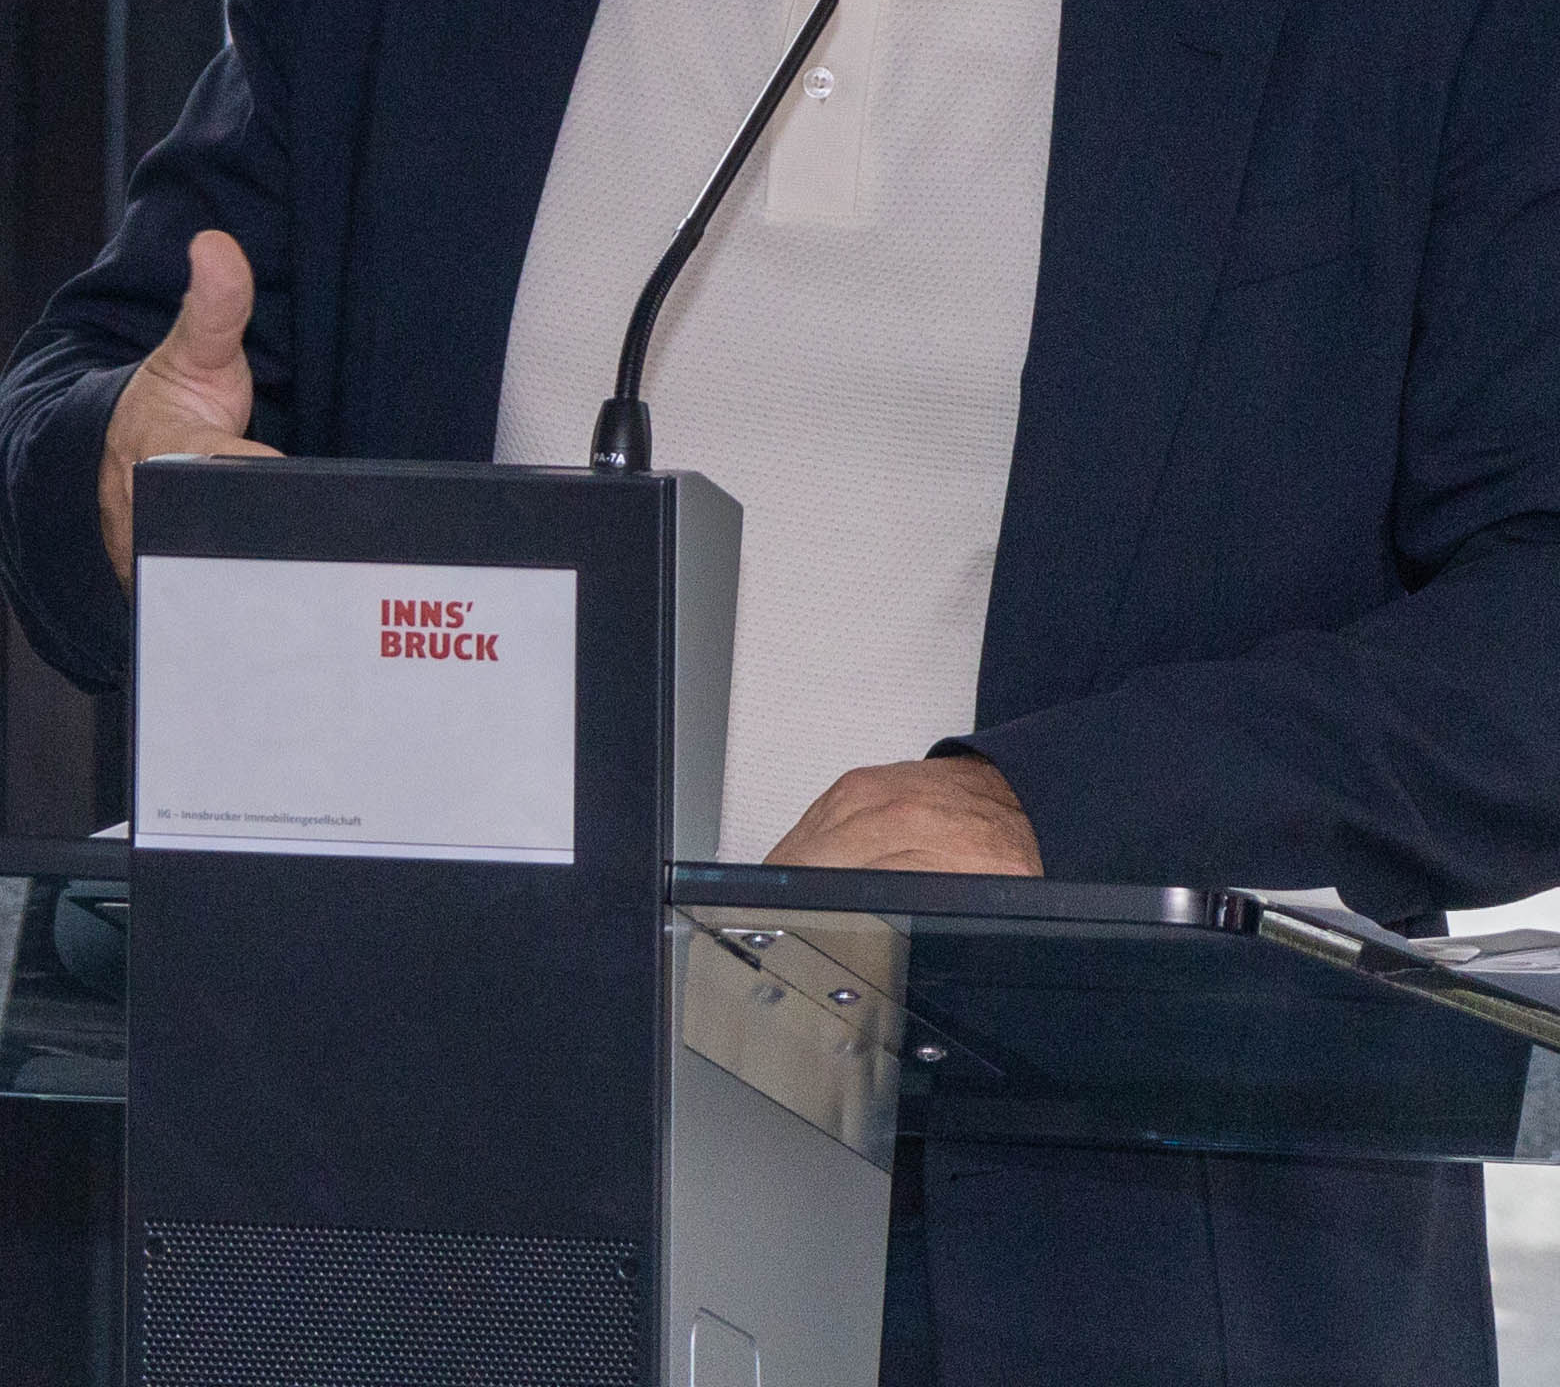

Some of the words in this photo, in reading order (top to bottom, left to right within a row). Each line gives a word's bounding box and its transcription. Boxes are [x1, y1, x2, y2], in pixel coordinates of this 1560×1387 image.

[381, 599, 473, 628] INNS'
[381, 630, 499, 661] BRUCK
[181, 810, 241, 822] Innsbrucker
[244, 813, 363, 827] Immobiliengesellschaft
